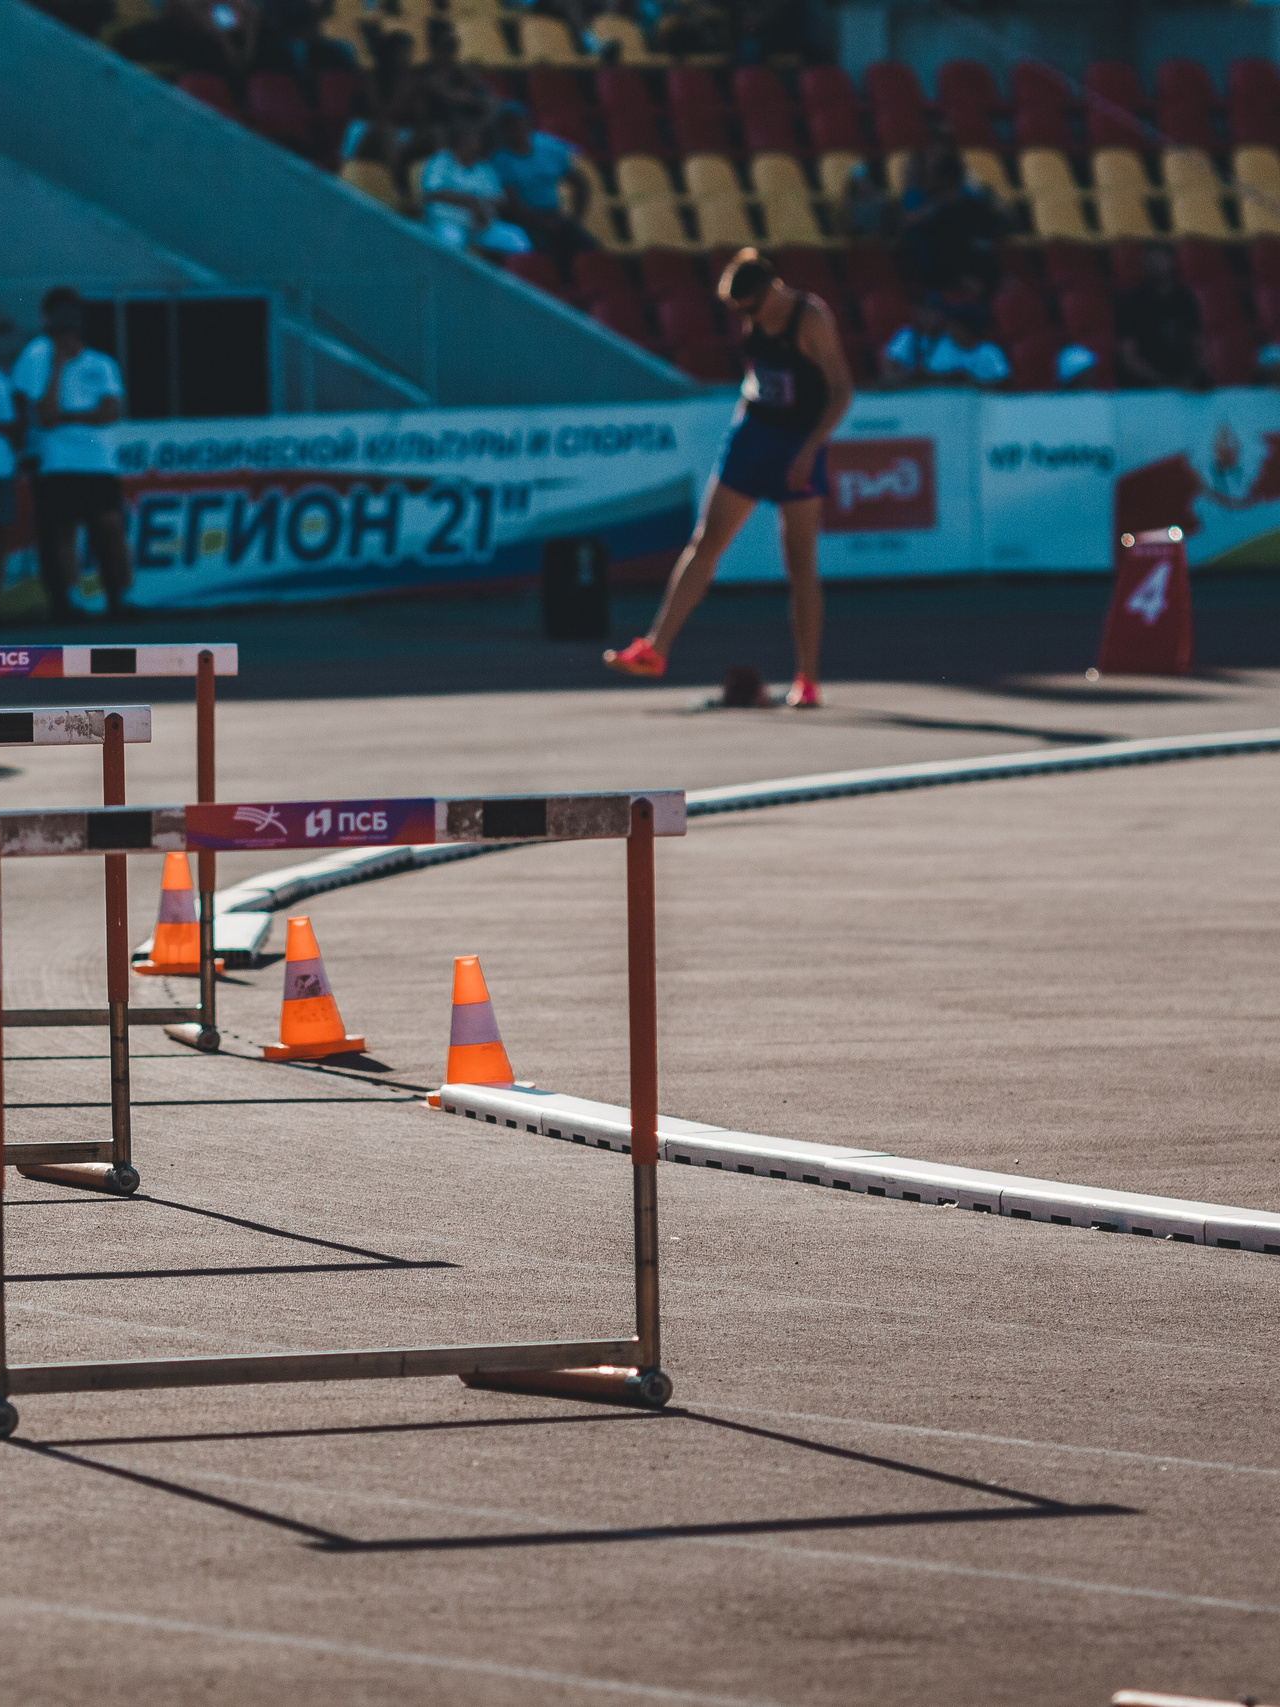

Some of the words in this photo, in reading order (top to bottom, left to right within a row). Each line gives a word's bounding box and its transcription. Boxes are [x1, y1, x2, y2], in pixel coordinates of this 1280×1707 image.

[136, 489, 403, 567] ЕГИОН
[1127, 561, 1171, 622] 4
[339, 811, 388, 831] ПСБ
